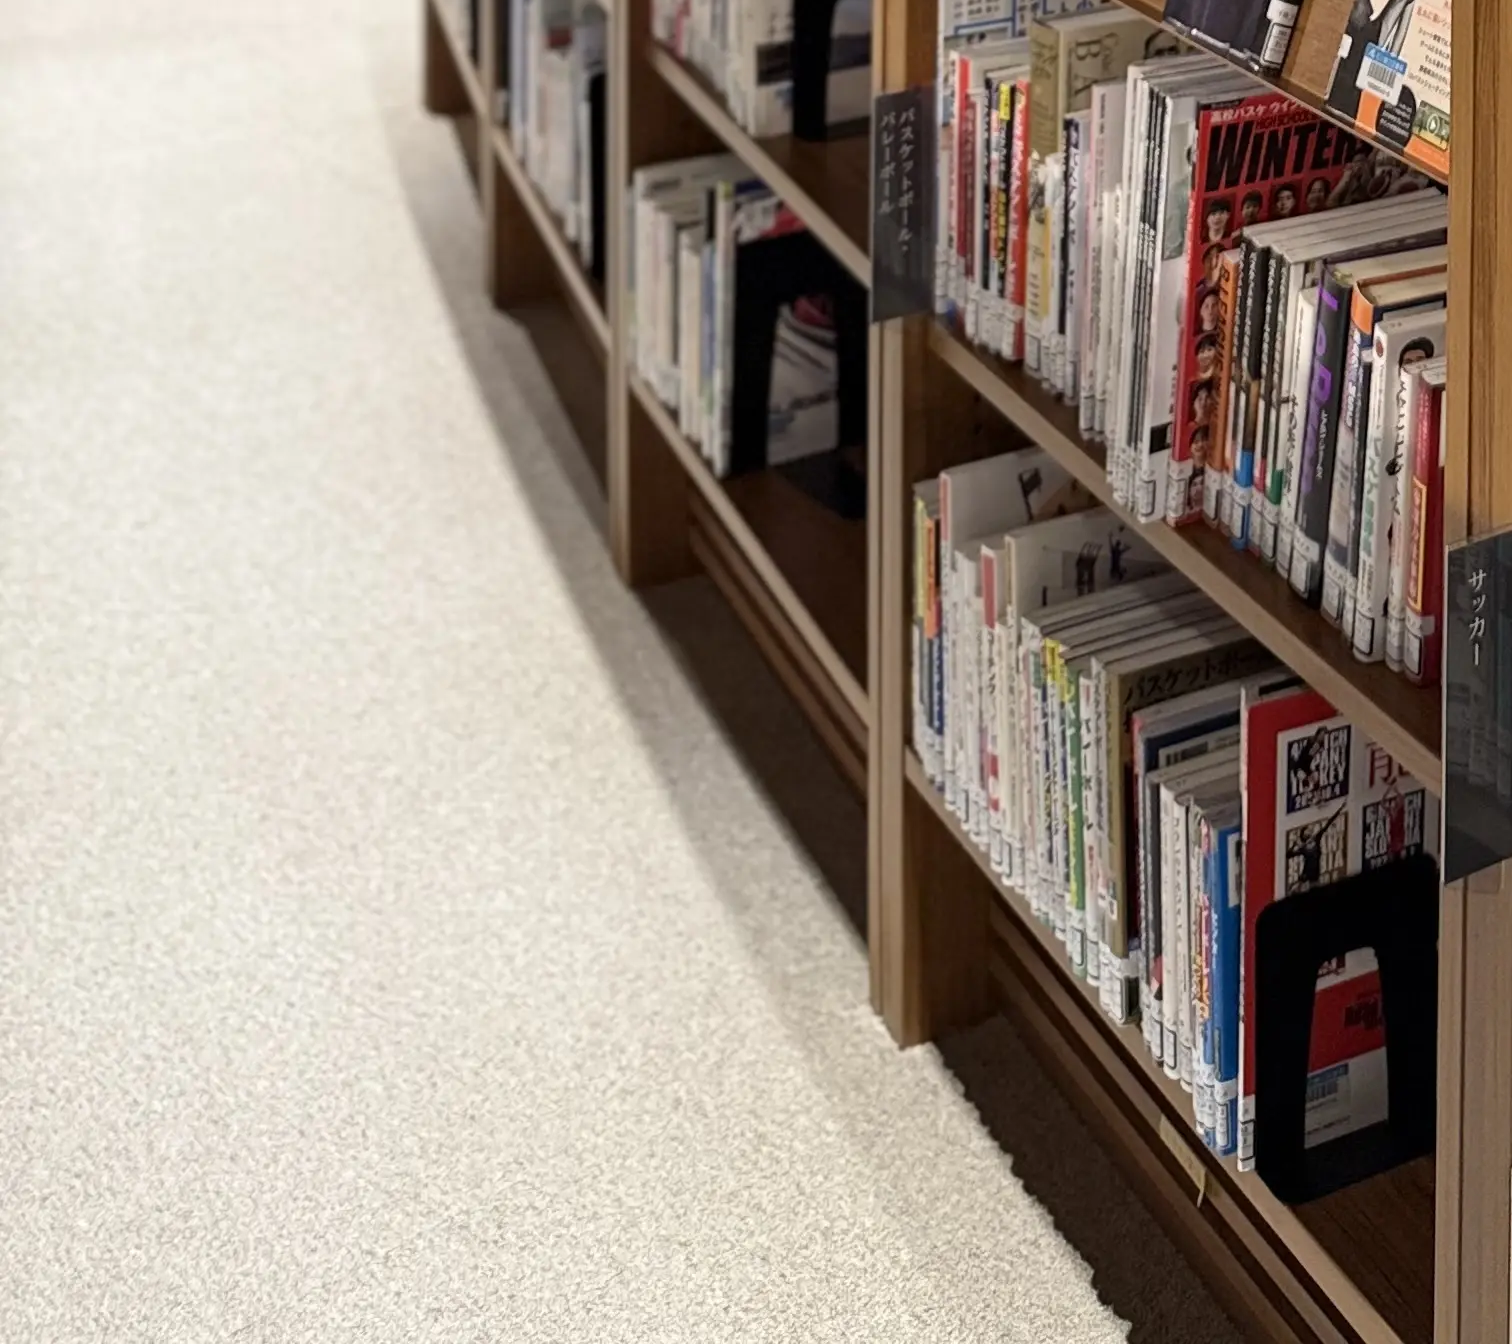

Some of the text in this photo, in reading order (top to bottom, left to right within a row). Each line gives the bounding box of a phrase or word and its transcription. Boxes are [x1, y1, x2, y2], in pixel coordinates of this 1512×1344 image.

[878, 111, 898, 214] バレーボール
[1467, 568, 1488, 667] サッカー
